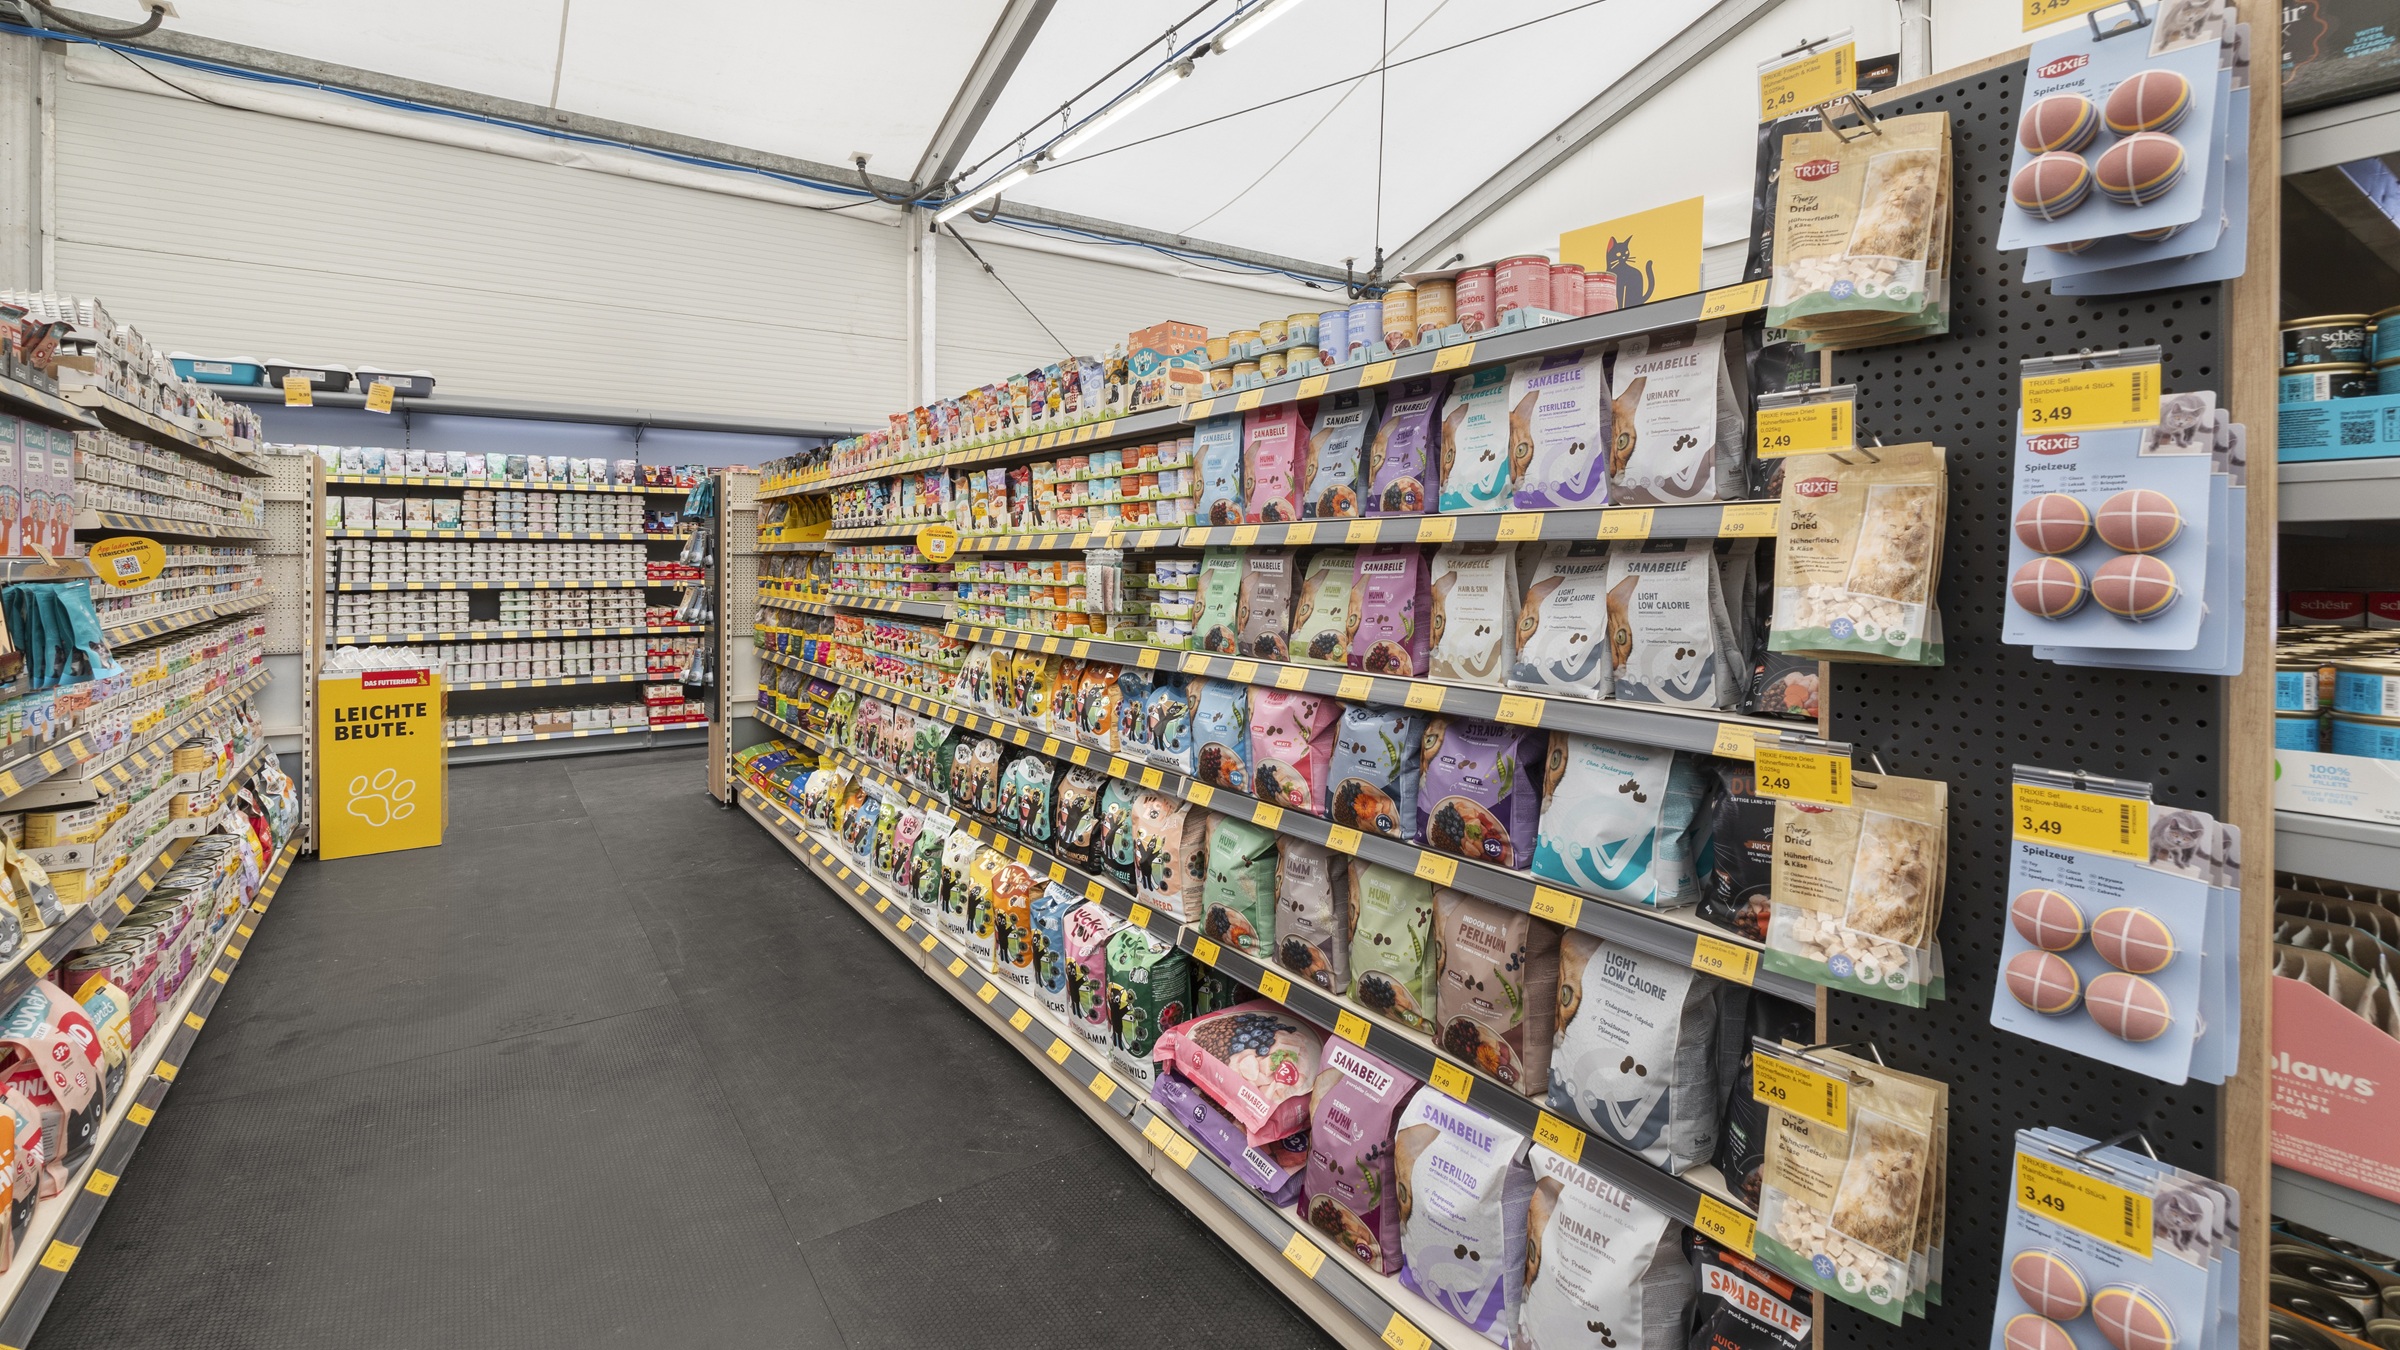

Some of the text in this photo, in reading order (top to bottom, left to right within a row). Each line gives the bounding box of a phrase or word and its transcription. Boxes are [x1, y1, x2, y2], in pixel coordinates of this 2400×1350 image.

[1764, 58, 1819, 82] TRIXIE Freeze Dried
[1807, 65, 1821, 75] Käse
[1764, 85, 1785, 96] 0,025kg
[2033, 79, 2086, 97] Spielzeug
[1766, 91, 1795, 111] 2,49
[1789, 203, 1819, 213] Dried
[1788, 213, 1840, 224] Hühnerfleisch
[1706, 304, 1725, 314] 4,99
[1634, 354, 1698, 375] SANABELLE
[1528, 369, 1581, 389] SANABELLE
[1787, 368, 1819, 383] BEEF
[2028, 379, 2056, 388] TRIXIE
[2028, 385, 2083, 396] Rainbow-Bälle
[2092, 380, 2115, 389] Stück
[1460, 386, 1503, 402] SANABELLE
[1646, 389, 1680, 401] URINARY
[1394, 401, 1429, 414] SANABELLE
[1539, 400, 1576, 412] STERILIZED
[1326, 414, 1360, 425] SANABELLE
[1468, 414, 1486, 423] DENTAL
[1760, 411, 1779, 419] TRIXIE
[1780, 410, 1799, 418] Freeze
[1760, 417, 1797, 426] Hühnerfleisch
[2031, 406, 2072, 424] 3,49
[1203, 433, 1231, 443] SANABELLE
[1254, 427, 1285, 439] SANABELLE
[1762, 435, 1791, 449] 2,49
[2024, 461, 2077, 473] Spielzeug
[1500, 527, 1515, 536] 5,29
[1602, 525, 1619, 535] 5,29
[1723, 523, 1744, 533] 4,99
[1790, 521, 1817, 530] Dried
[1789, 537, 1840, 545] Hühnerfleisch
[1253, 562, 1281, 570] SANABELLE
[1364, 562, 1403, 571] SANABELLE
[1447, 560, 1490, 569] SANABELLE
[1554, 563, 1604, 575] SANABELLE
[1628, 561, 1688, 572] SANABELLE
[1558, 588, 1575, 596] LIGHT
[1569, 594, 1595, 602] CALORIE
[1656, 601, 1690, 609] CALORIE
[378, 678, 417, 686] FUTTERHAUS
[335, 703, 426, 723] LEICHTE
[1500, 708, 1515, 719] 5,29
[335, 722, 414, 741] BEUTE.
[1717, 742, 1739, 753] 4,99
[1759, 751, 1814, 763] TRIXIE Freeze Dried
[1759, 759, 1796, 768] Hühnerfleisch
[1761, 776, 1790, 789] 2,49
[2309, 773, 2352, 783] NATURAL
[2313, 779, 2349, 789] FILLETS
[2019, 787, 2061, 800] TRIXIE Set
[2019, 796, 2072, 810] Rainbow-Bälle
[2081, 805, 2104, 814] Stück
[2022, 816, 2062, 835] 3,49
[1784, 835, 1811, 846] Dried
[1783, 851, 1833, 866] Hühnerfleisch
[2022, 845, 2075, 864] Spielzeug
[1419, 864, 1435, 876] 17,49
[1792, 860, 1808, 869] Käse
[1368, 887, 1391, 904] HUHN
[1534, 901, 1555, 915] 22,99
[1463, 914, 1497, 933] INDOOR MIT
[1606, 951, 1637, 973] LIGHT
[1697, 953, 1723, 969] 14,99
[1012, 974, 1030, 985] ENTE
[1603, 964, 1667, 1001] LOW CALORIE
[1130, 1065, 1148, 1080] WILD
[1334, 1051, 1388, 1091] SANABELLE
[1755, 1055, 1810, 1079] TRIXIE Freeze Dried
[1432, 1072, 1450, 1088] 17,49
[1797, 1078, 1813, 1088] Käse
[1758, 1080, 1787, 1100] 2,49
[2278, 1085, 2329, 1105] FILLET
[1240, 1089, 1268, 1115] SANABELLE
[2276, 1093, 2330, 1115] PRAWN
[1328, 1108, 1352, 1130] HUHN
[1422, 1104, 1493, 1153] SANABELLE
[1782, 1117, 1809, 1136] Dried
[1538, 1128, 1560, 1145] 22,99
[1245, 1149, 1273, 1177] SANABELLE
[2021, 1156, 2064, 1176] TRIXIE Set
[1430, 1154, 1478, 1190] STERILIZED
[1544, 1156, 1634, 1213] SANABELLE
[2021, 1165, 2076, 1188] Rainbow-Bälle
[2084, 1187, 2108, 1201] Stück
[2025, 1185, 2065, 1212] 3,49
[1559, 1211, 1611, 1250] URINARY
[1701, 1216, 1725, 1235] 14,99
[1710, 1270, 1804, 1333] SANABELLE
[1728, 1309, 1783, 1342] makes your cat
